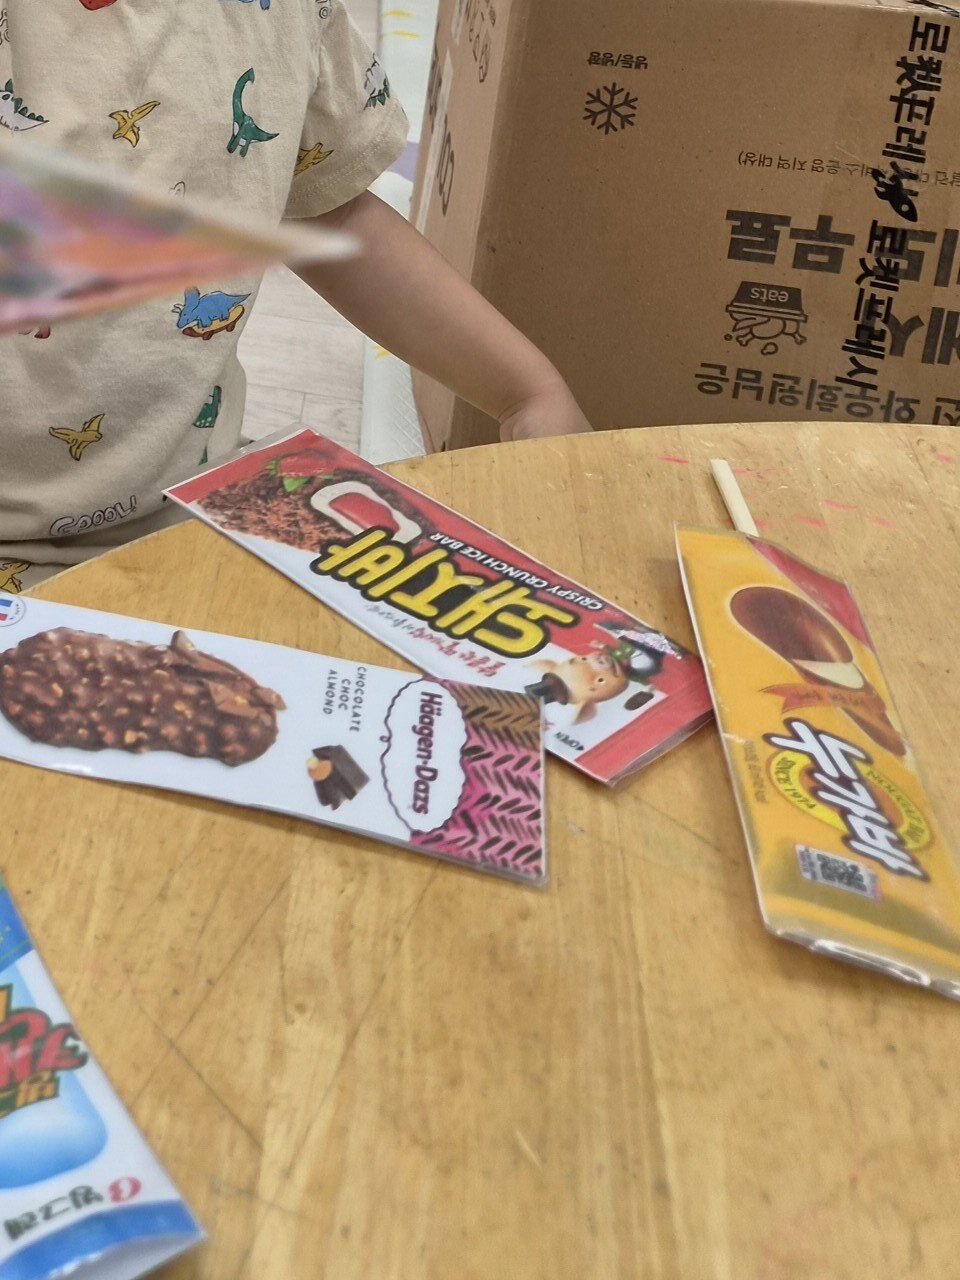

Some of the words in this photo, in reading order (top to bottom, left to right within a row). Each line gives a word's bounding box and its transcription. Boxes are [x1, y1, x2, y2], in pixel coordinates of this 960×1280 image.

[587, 51, 648, 70] 냉동/냉장
[738, 150, 773, 168] 대상)
[777, 155, 805, 171] 지역
[725, 209, 855, 274] 무료
[750, 286, 789, 303] eats
[835, 219, 908, 390] 로켓프레시
[694, 362, 920, 423] 와우회원님은
[429, 531, 465, 550] BAR
[460, 546, 488, 562] ICE
[484, 556, 548, 589] CRUNCH
[310, 528, 580, 657] 돼지바
[545, 585, 603, 610] CRISPY
[324, 668, 337, 715] ALMOND
[339, 677, 351, 711] CHOC
[351, 665, 368, 733] CHOCOLATE
[413, 691, 443, 816] Häagen-Dazs
[762, 717, 930, 882] 누가바
